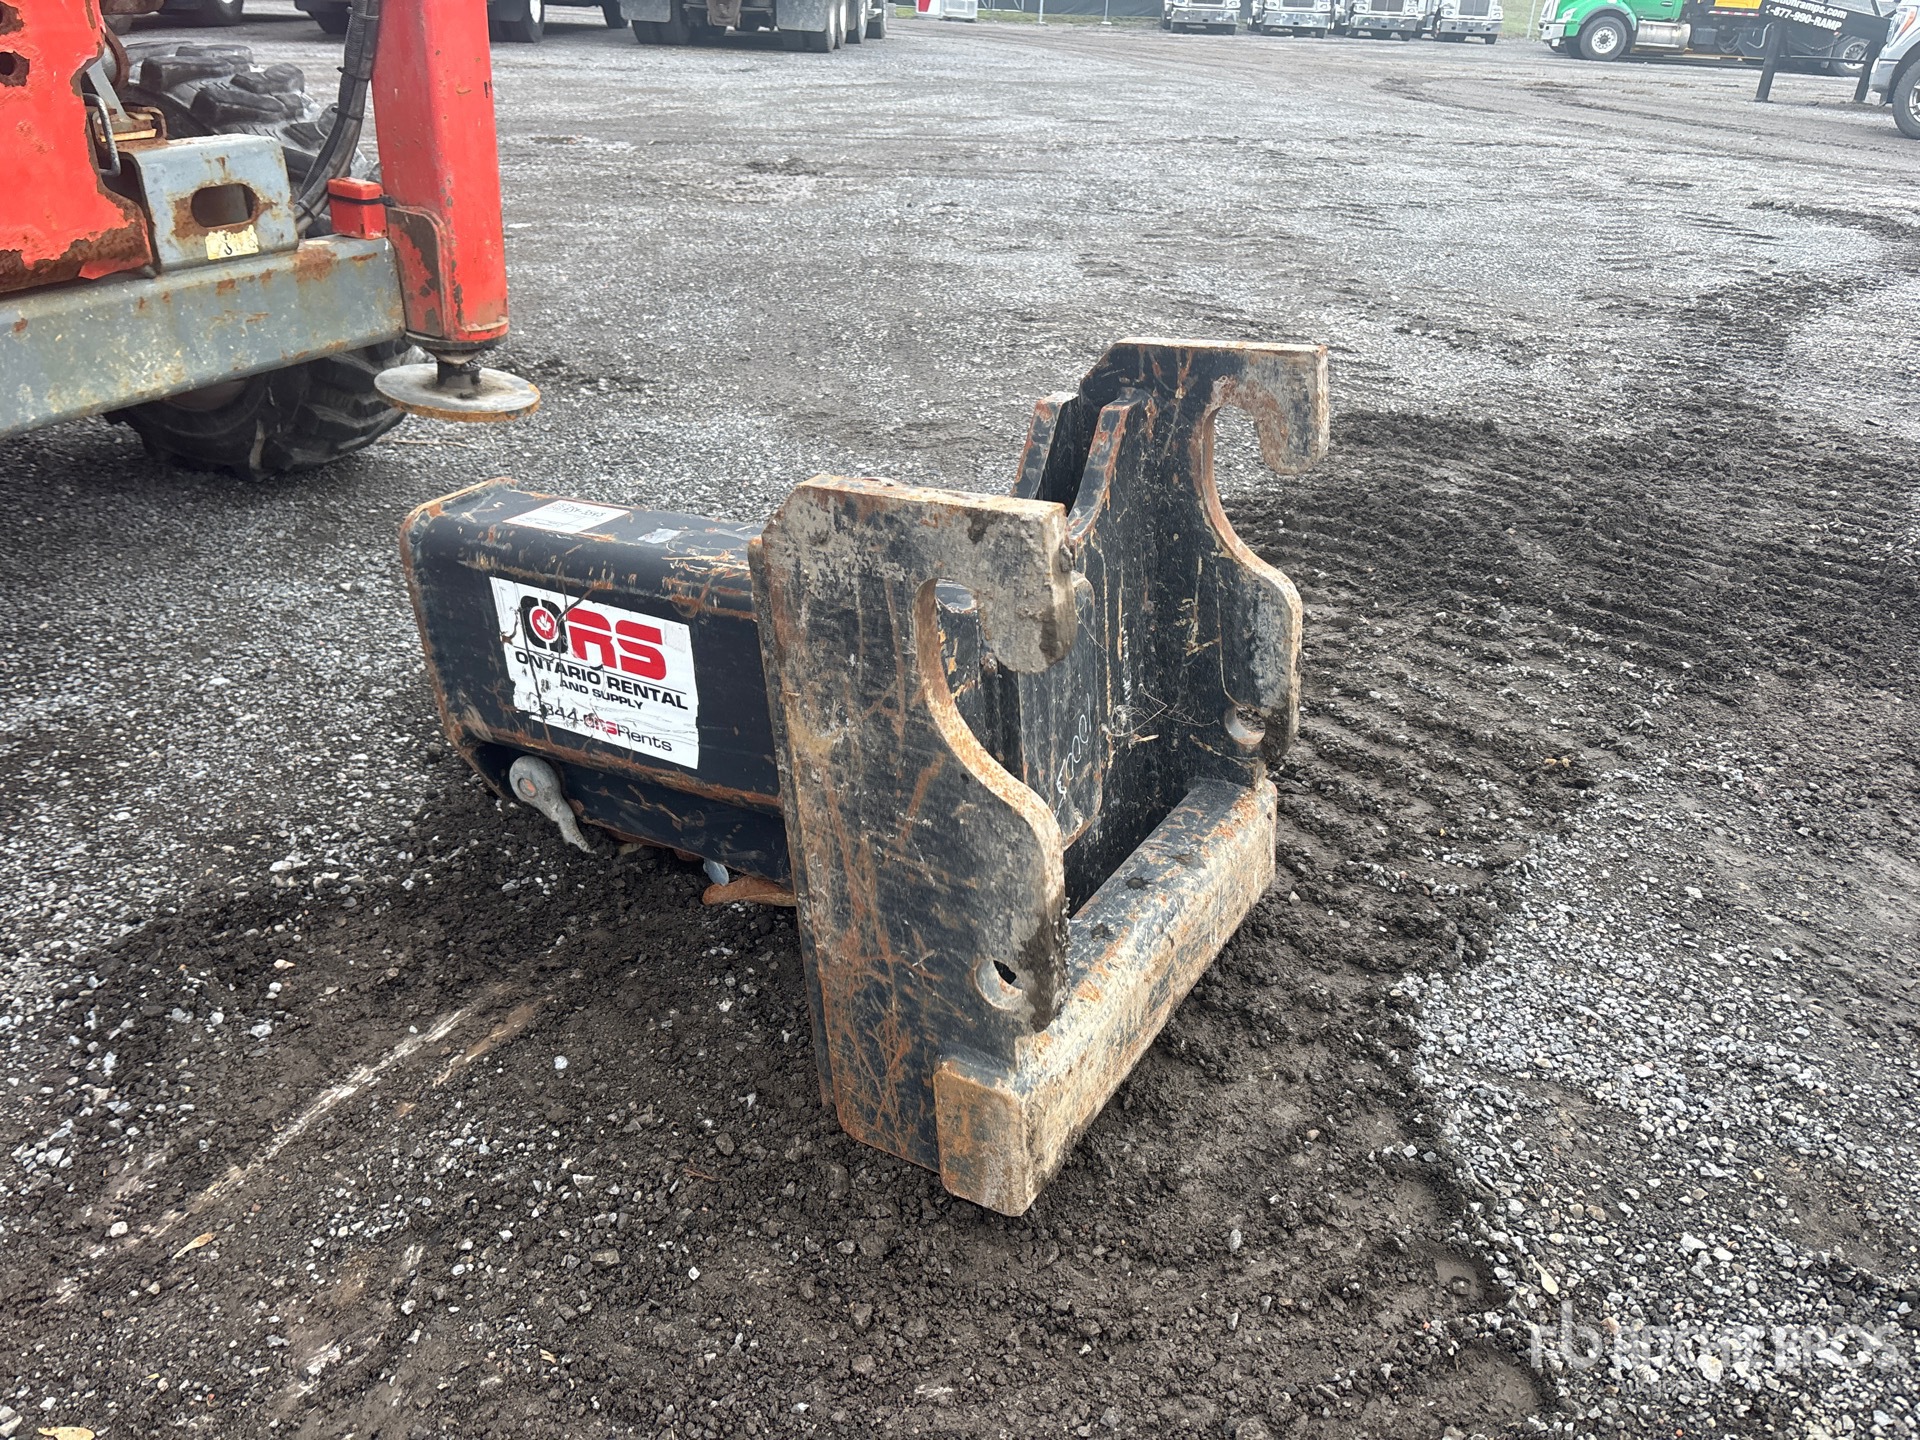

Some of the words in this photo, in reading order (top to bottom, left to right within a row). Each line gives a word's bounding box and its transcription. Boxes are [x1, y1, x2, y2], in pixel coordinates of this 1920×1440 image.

[520, 595, 667, 681] ORS
[515, 651, 601, 685] ONTARIO
[606, 675, 689, 710] RENTAL
[560, 679, 589, 695] AND
[592, 688, 643, 710] SUPPLY
